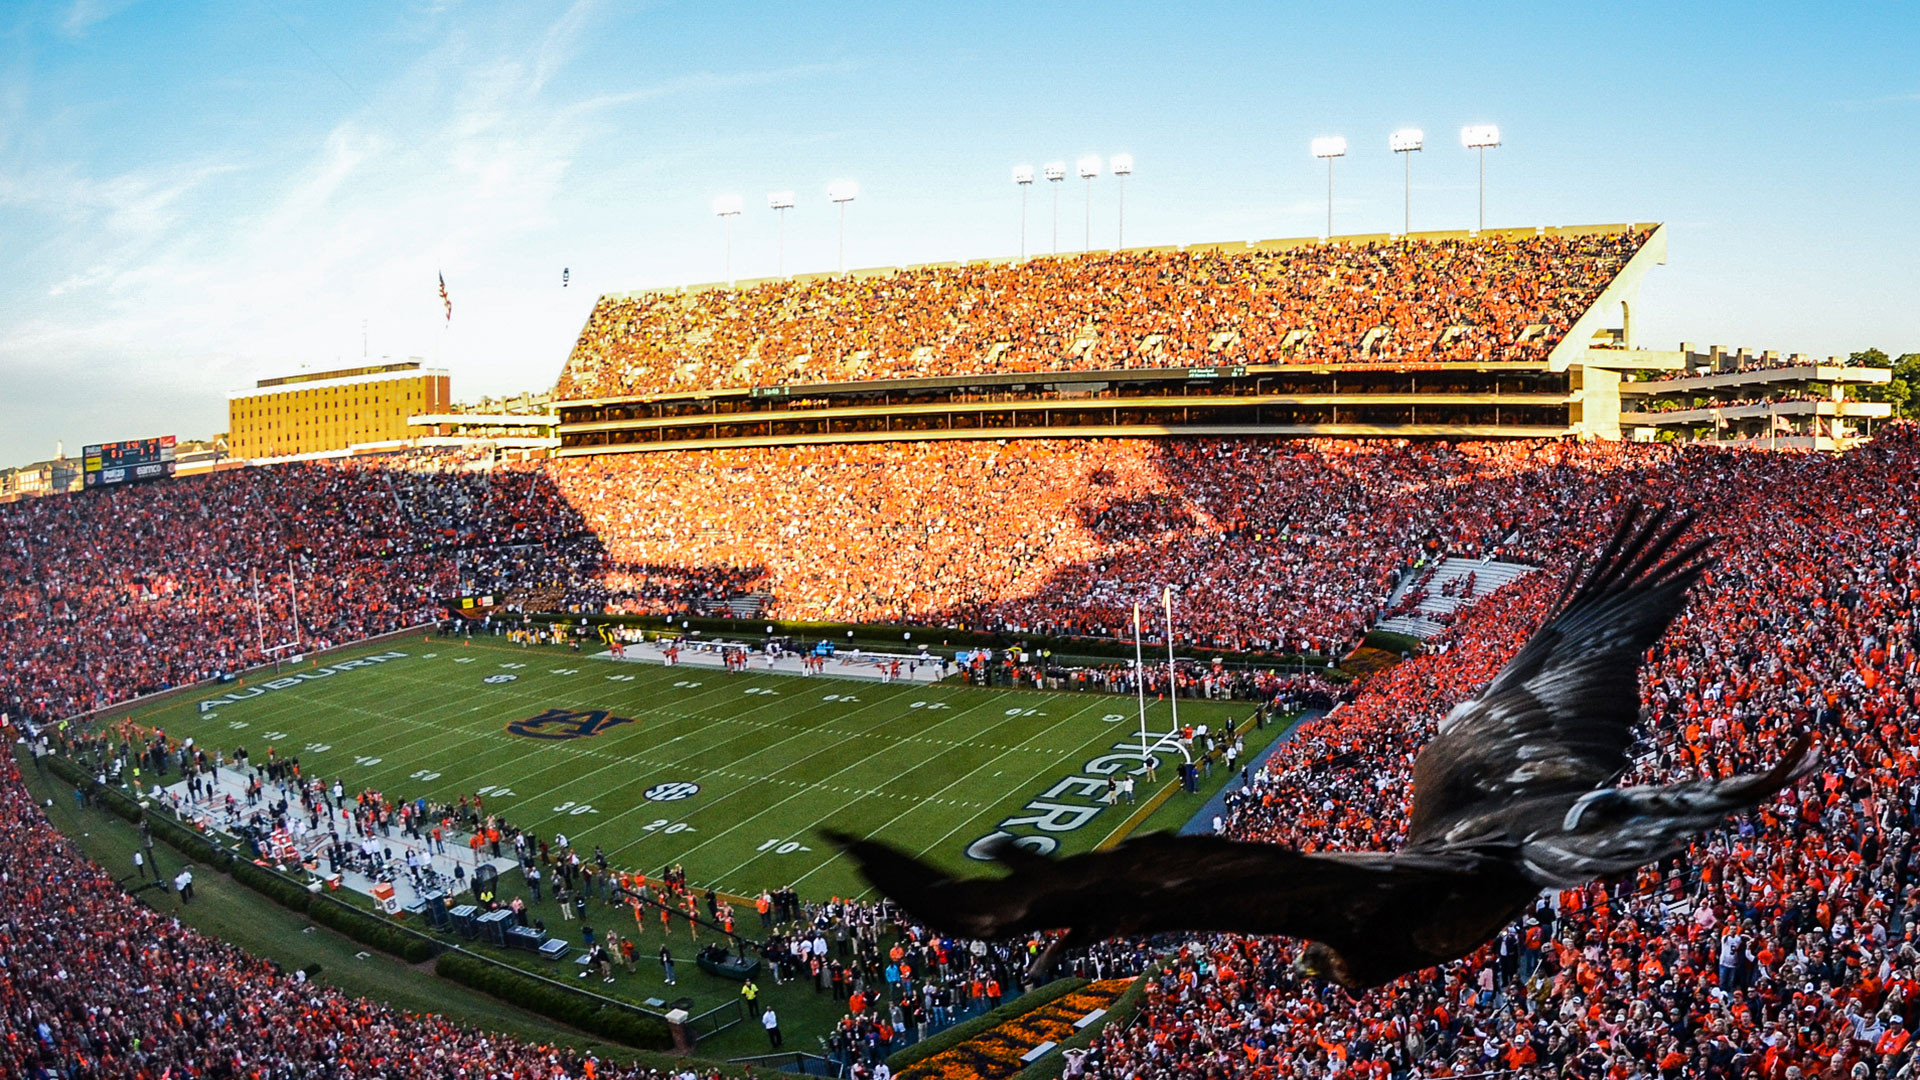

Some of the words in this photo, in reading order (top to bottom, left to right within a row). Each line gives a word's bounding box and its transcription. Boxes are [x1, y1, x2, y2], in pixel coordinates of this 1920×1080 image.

[199, 651, 409, 713] AUBURN
[644, 781, 700, 801] SEC
[553, 801, 593, 815] 30
[641, 819, 689, 835] 20
[756, 838, 801, 855] 10
